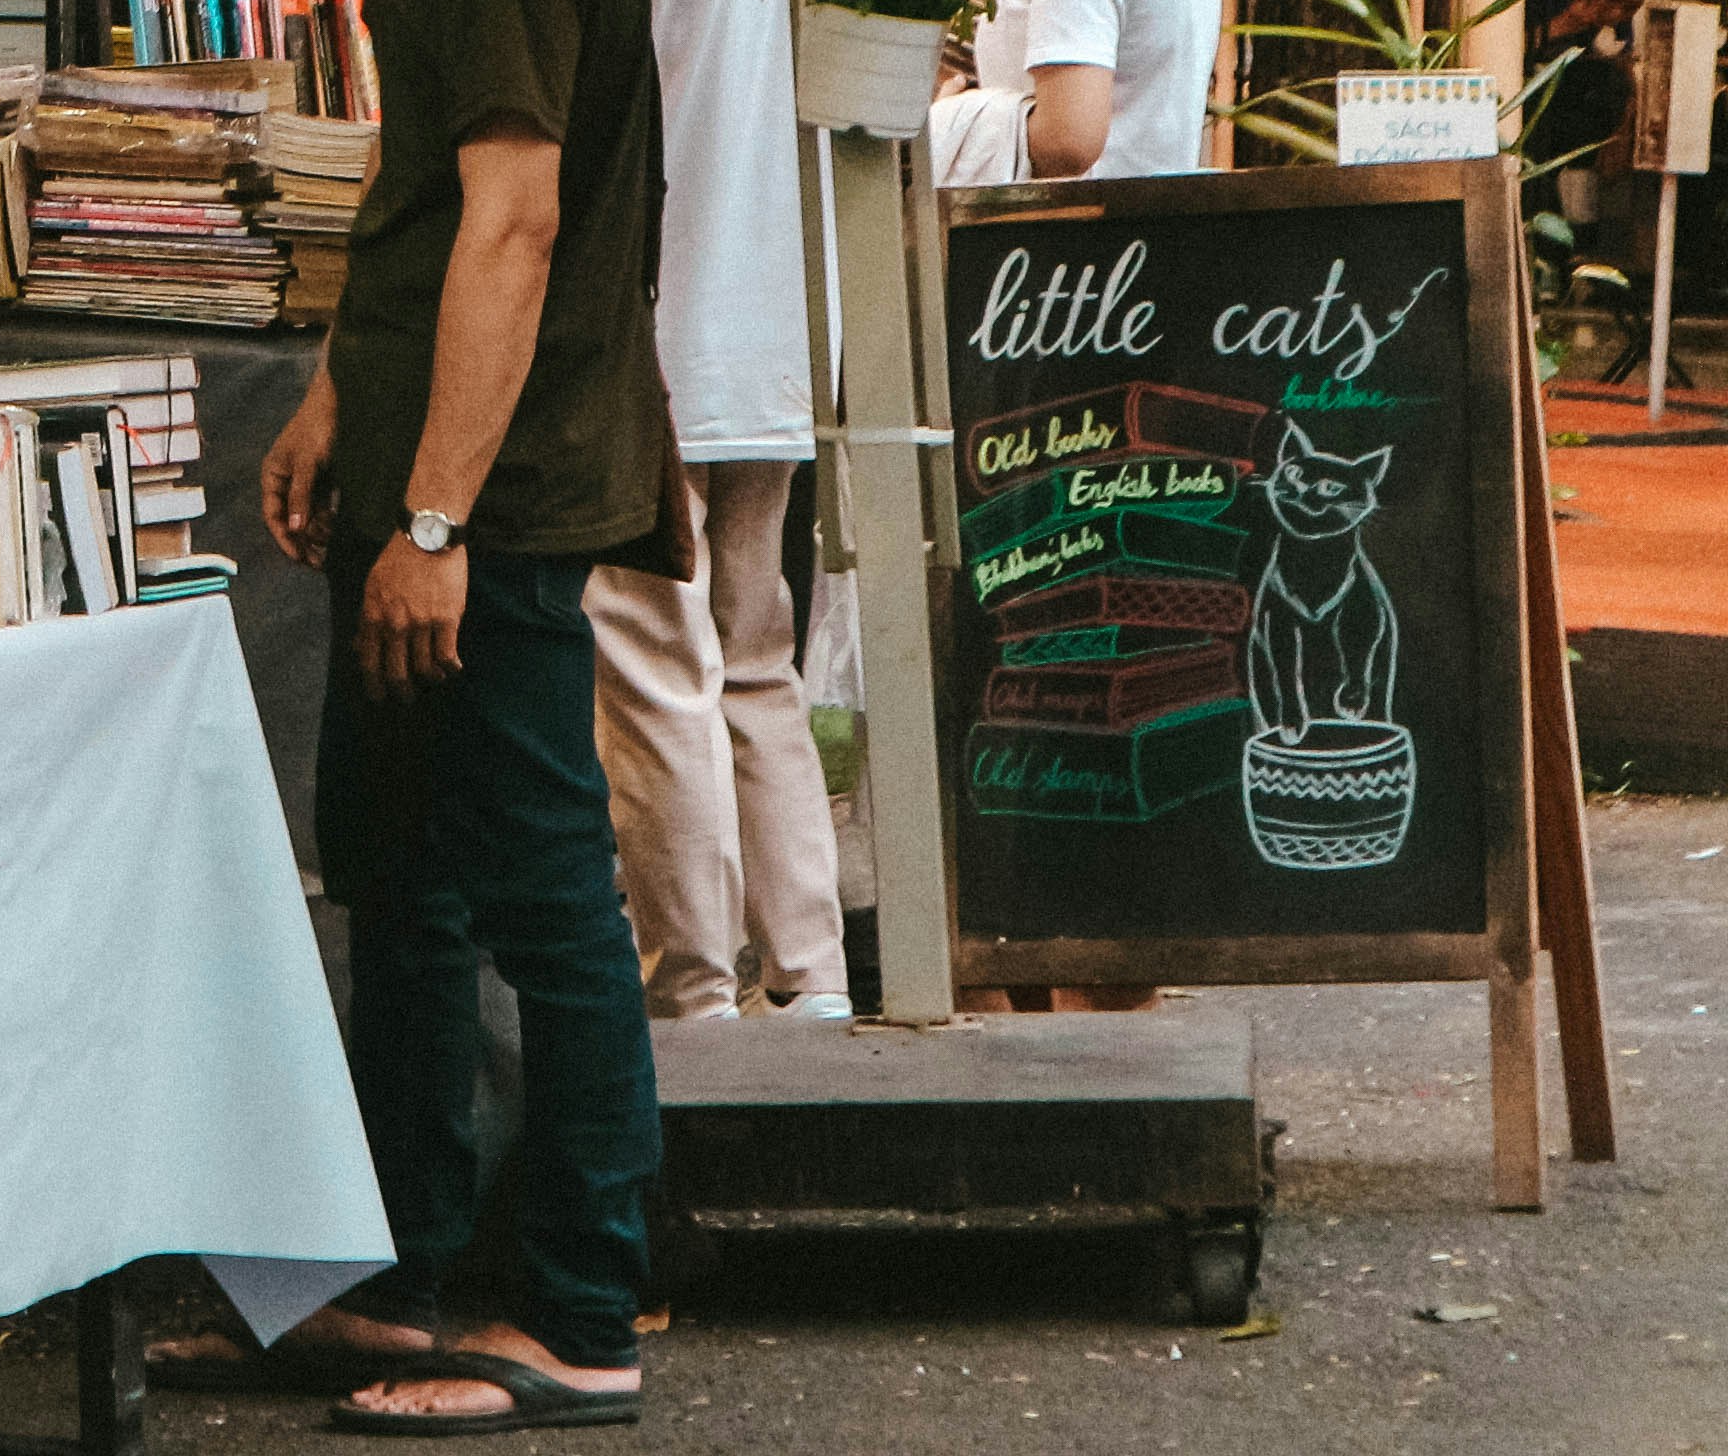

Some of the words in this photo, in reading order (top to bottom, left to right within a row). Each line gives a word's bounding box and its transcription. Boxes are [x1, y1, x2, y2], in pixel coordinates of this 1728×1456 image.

[1385, 117, 1451, 140] SÁCH
[968, 239, 1163, 361] little
[1213, 258, 1394, 380] cats
[977, 427, 1038, 476] Old
[1044, 408, 1118, 459] books
[1068, 464, 1159, 509] English
[1164, 463, 1225, 496] books
